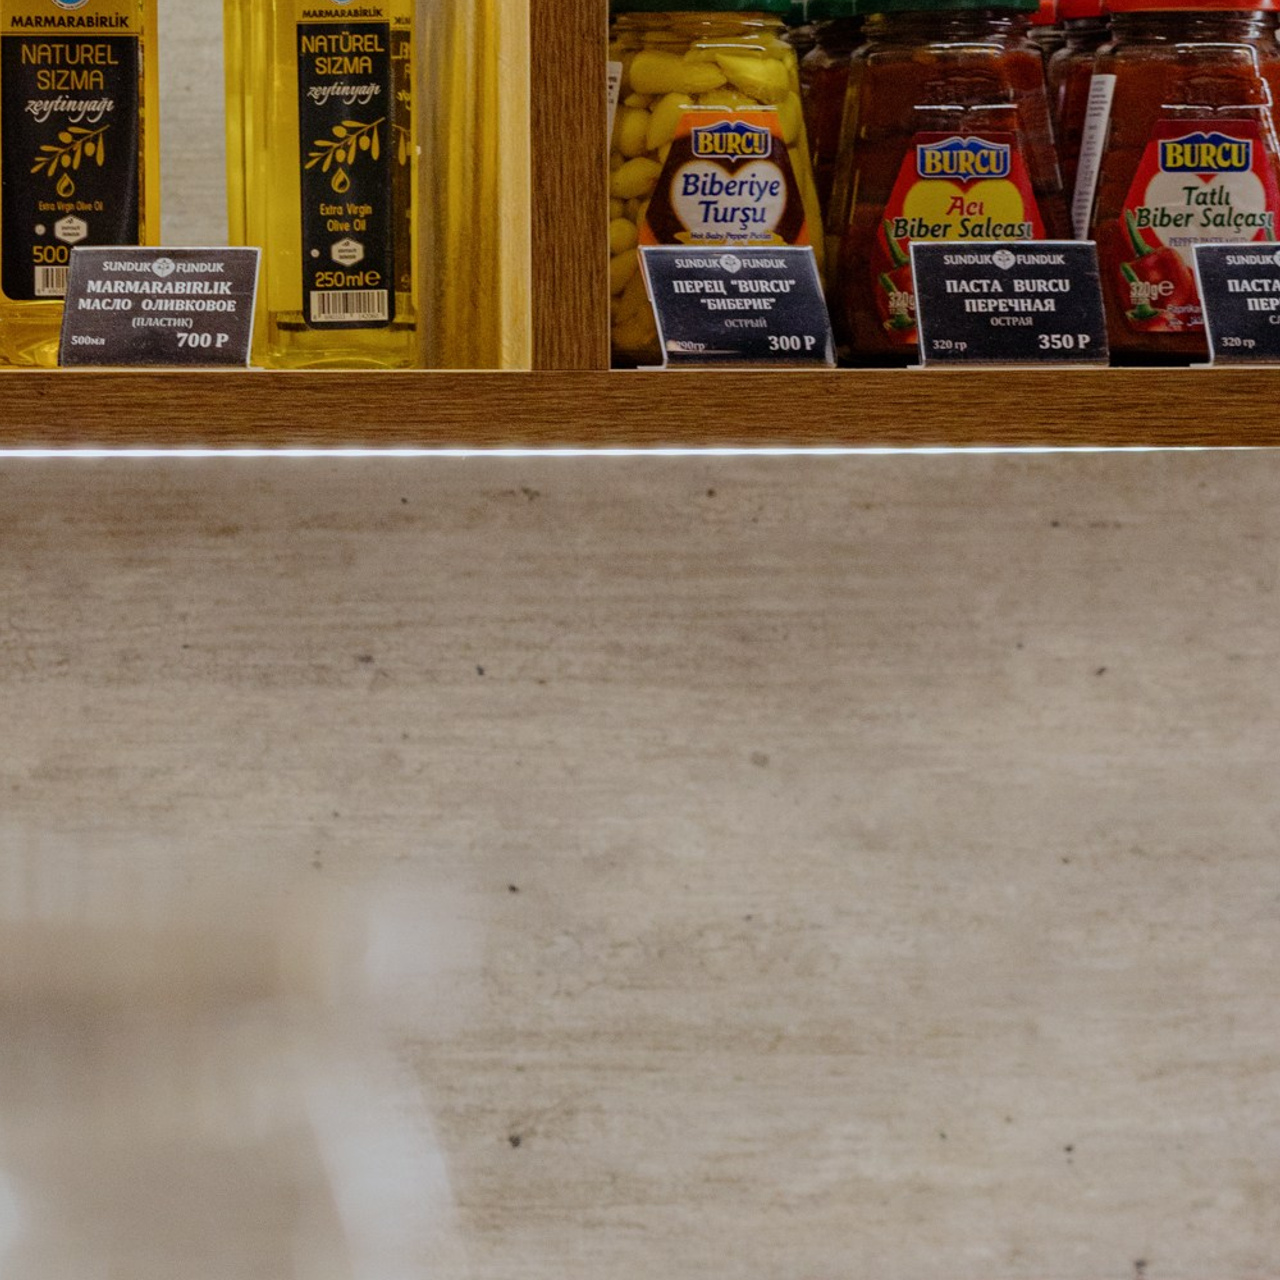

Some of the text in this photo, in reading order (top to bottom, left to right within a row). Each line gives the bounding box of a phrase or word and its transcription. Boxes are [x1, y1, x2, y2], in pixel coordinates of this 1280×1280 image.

[301, 31, 385, 54] NATÜREL
[315, 56, 373, 75] SIZMA
[37, 70, 104, 91] SIZMA
[698, 131, 767, 155] BURCU
[924, 149, 1004, 176] BURCU
[1165, 142, 1247, 170] BURCU
[682, 173, 780, 202] Biberiye
[1183, 186, 1231, 206] Tatlı
[320, 203, 373, 218] Extra Virgin
[946, 196, 984, 216] Acı
[698, 201, 766, 230] Turşu
[1136, 208, 1273, 233] Biber Salçası
[327, 219, 366, 232] Olive Oil
[893, 217, 1033, 240] Biber Salçası
[33, 245, 68, 264] 500
[943, 254, 1066, 265] SUNDUK FUNDUK
[1225, 254, 1275, 265] SUNDUK
[102, 261, 225, 273] SUNDUK FUNDUK
[675, 258, 788, 269] SUNDUK FUNDUK
[86, 280, 233, 295] MARMARABIRLIK
[672, 280, 727, 295] ПЕРЕЦ
[945, 279, 1070, 293] ПАСТА BURCU
[1227, 279, 1280, 292] ПАСТА
[78, 298, 237, 312] МАСЛО ОЛИВКОВОЕ
[964, 298, 1056, 313] ПЕРЕЧНАЯ
[132, 317, 194, 329] (ПЛАСТИК)
[724, 316, 767, 328] ОСТРЫЙ
[990, 317, 1033, 327] ОСТРАЯ
[71, 335, 105, 346] 500мл
[176, 333, 212, 348] 700
[768, 335, 801, 351] 300
[932, 339, 967, 351] 320 гр
[1038, 334, 1075, 350] 350
[1222, 337, 1256, 349] 320 гр
